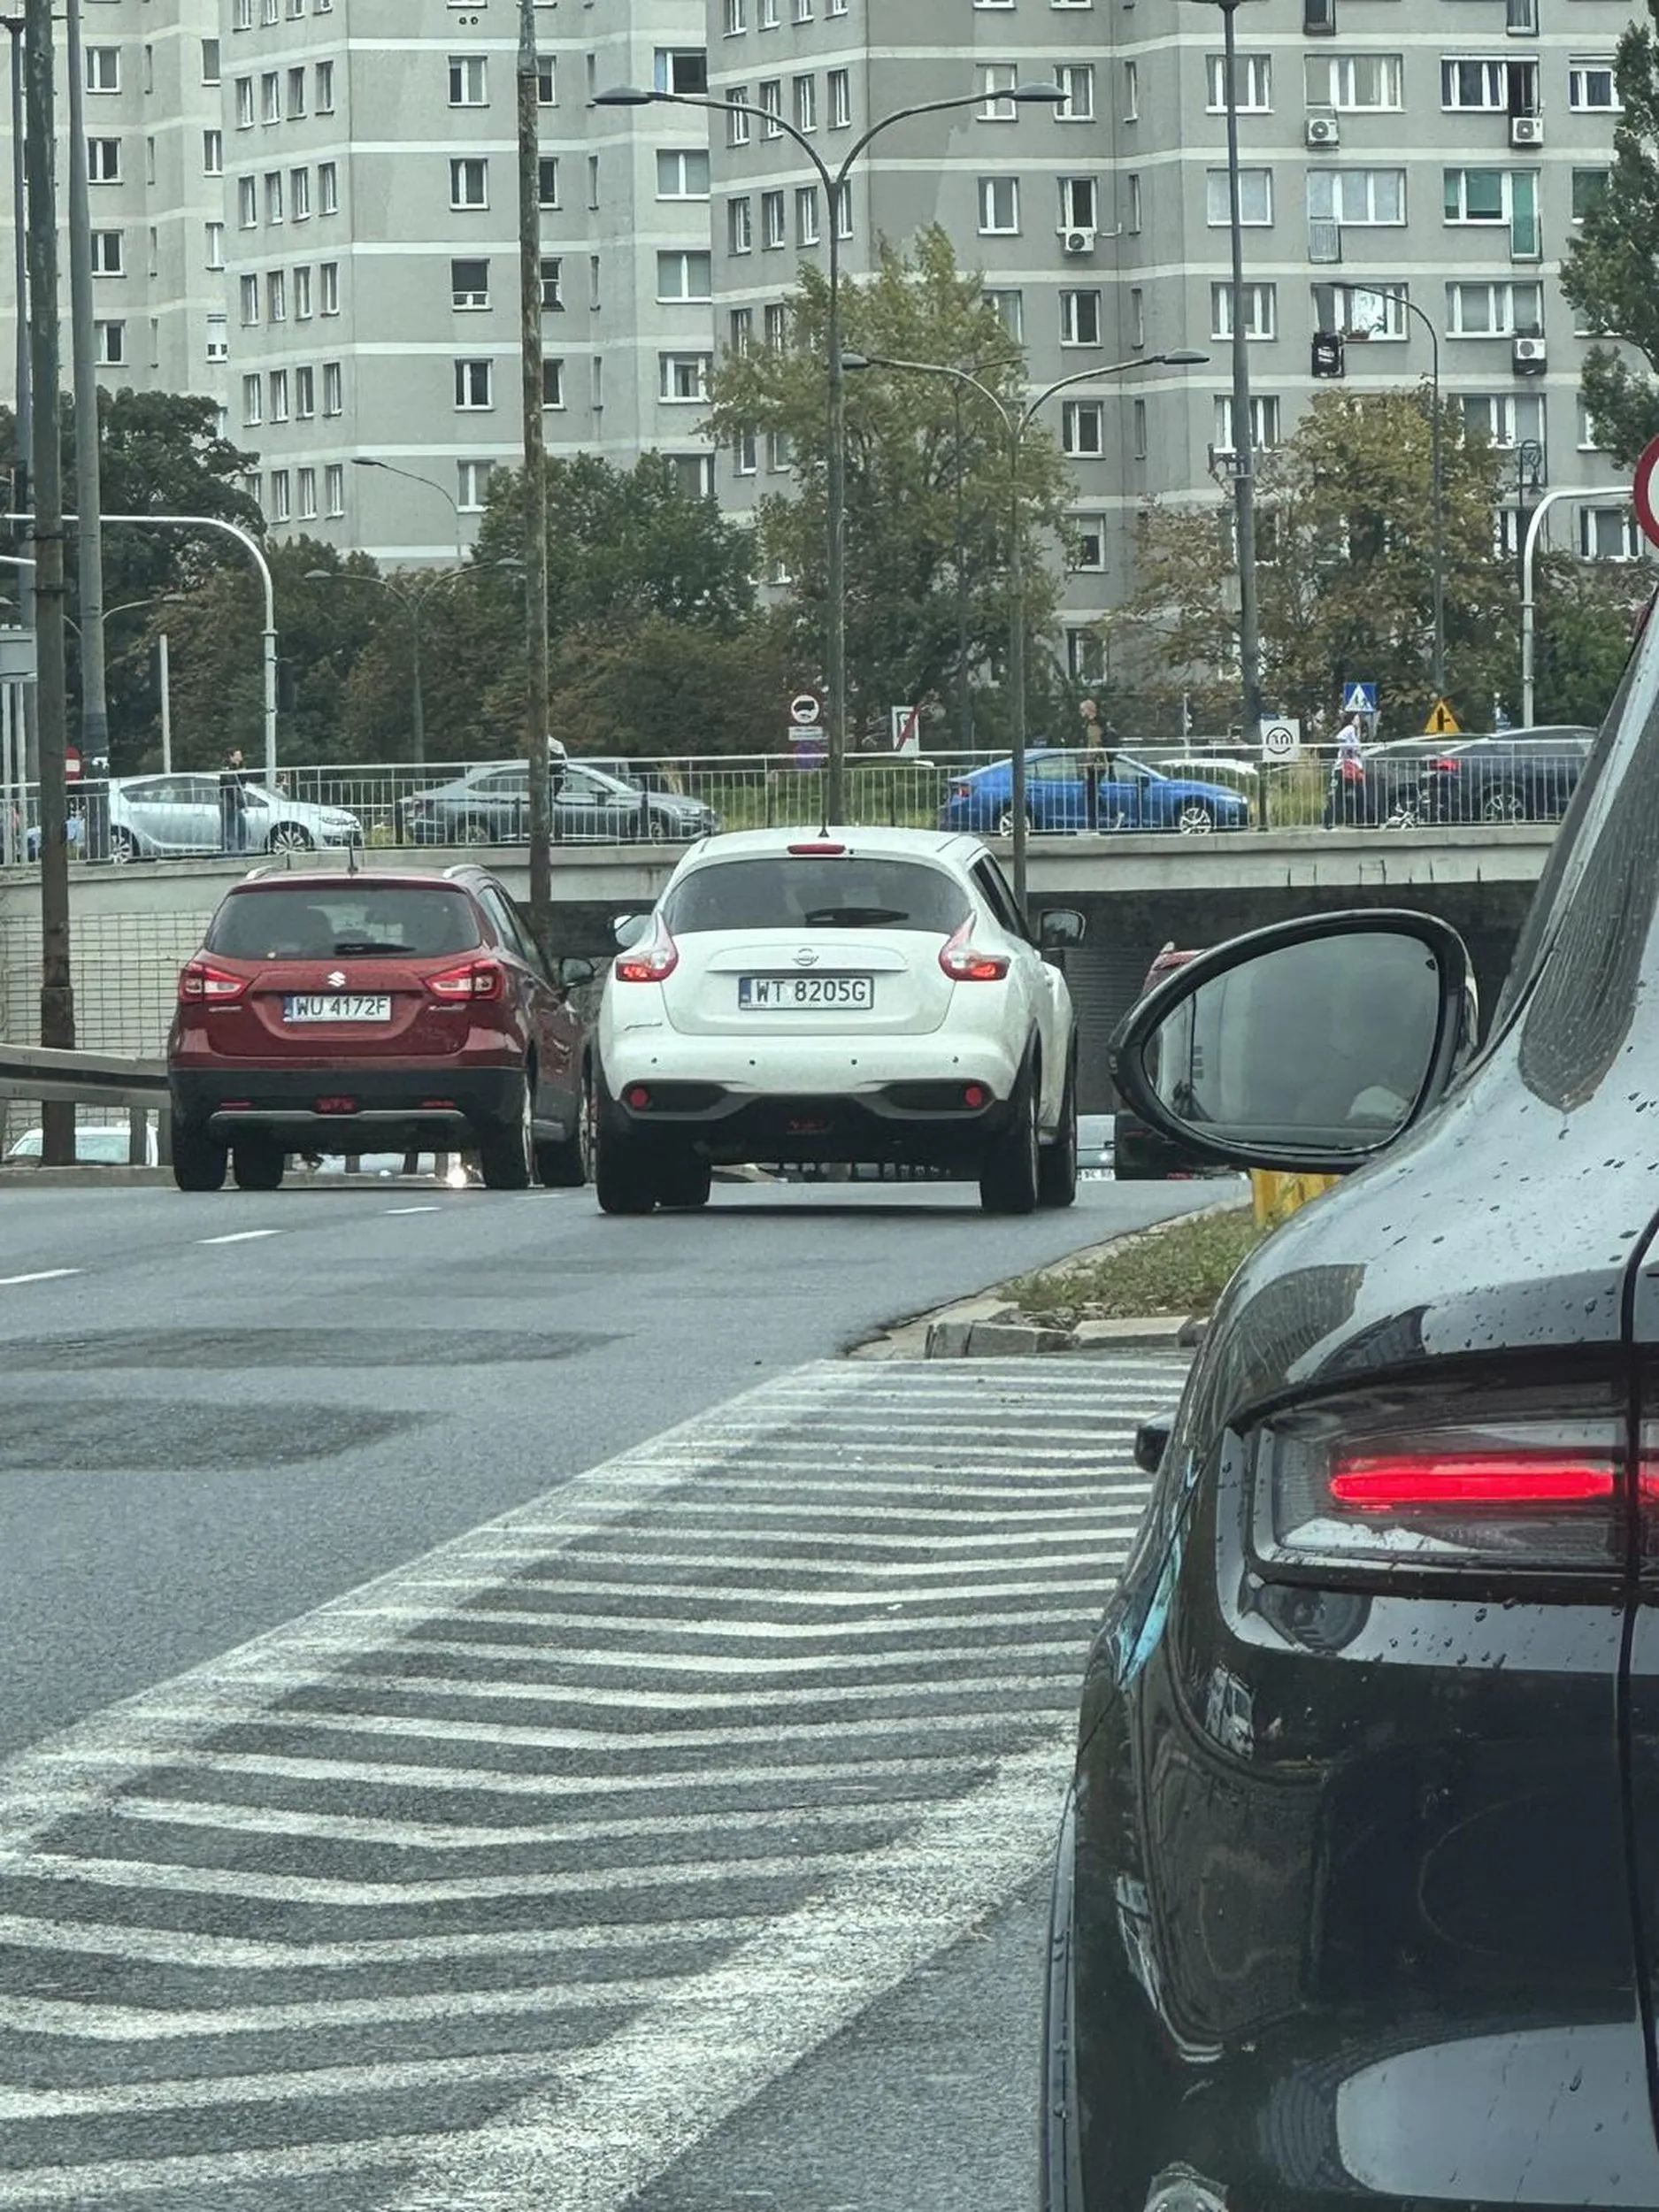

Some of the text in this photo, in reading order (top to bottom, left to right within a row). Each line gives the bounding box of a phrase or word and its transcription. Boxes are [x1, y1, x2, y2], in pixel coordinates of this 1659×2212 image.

[757, 980, 865, 1002] WT 8205G
[296, 997, 387, 1015] WU 4172F
